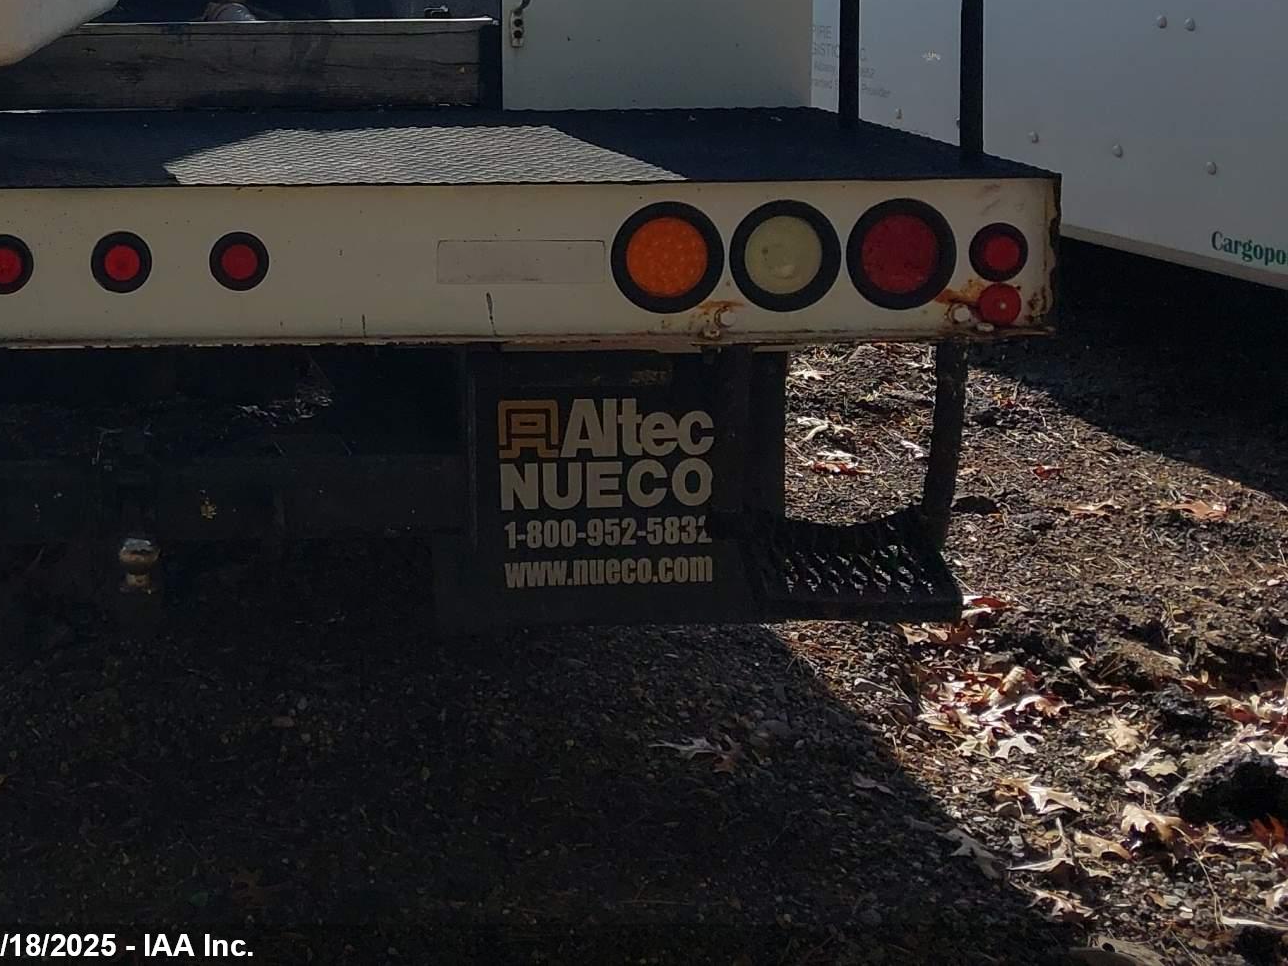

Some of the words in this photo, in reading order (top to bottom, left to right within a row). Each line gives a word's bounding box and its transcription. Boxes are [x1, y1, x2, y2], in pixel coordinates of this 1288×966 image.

[561, 398, 714, 458] Altec
[500, 457, 713, 511] NUECO
[505, 556, 713, 588] www.nueco.com
